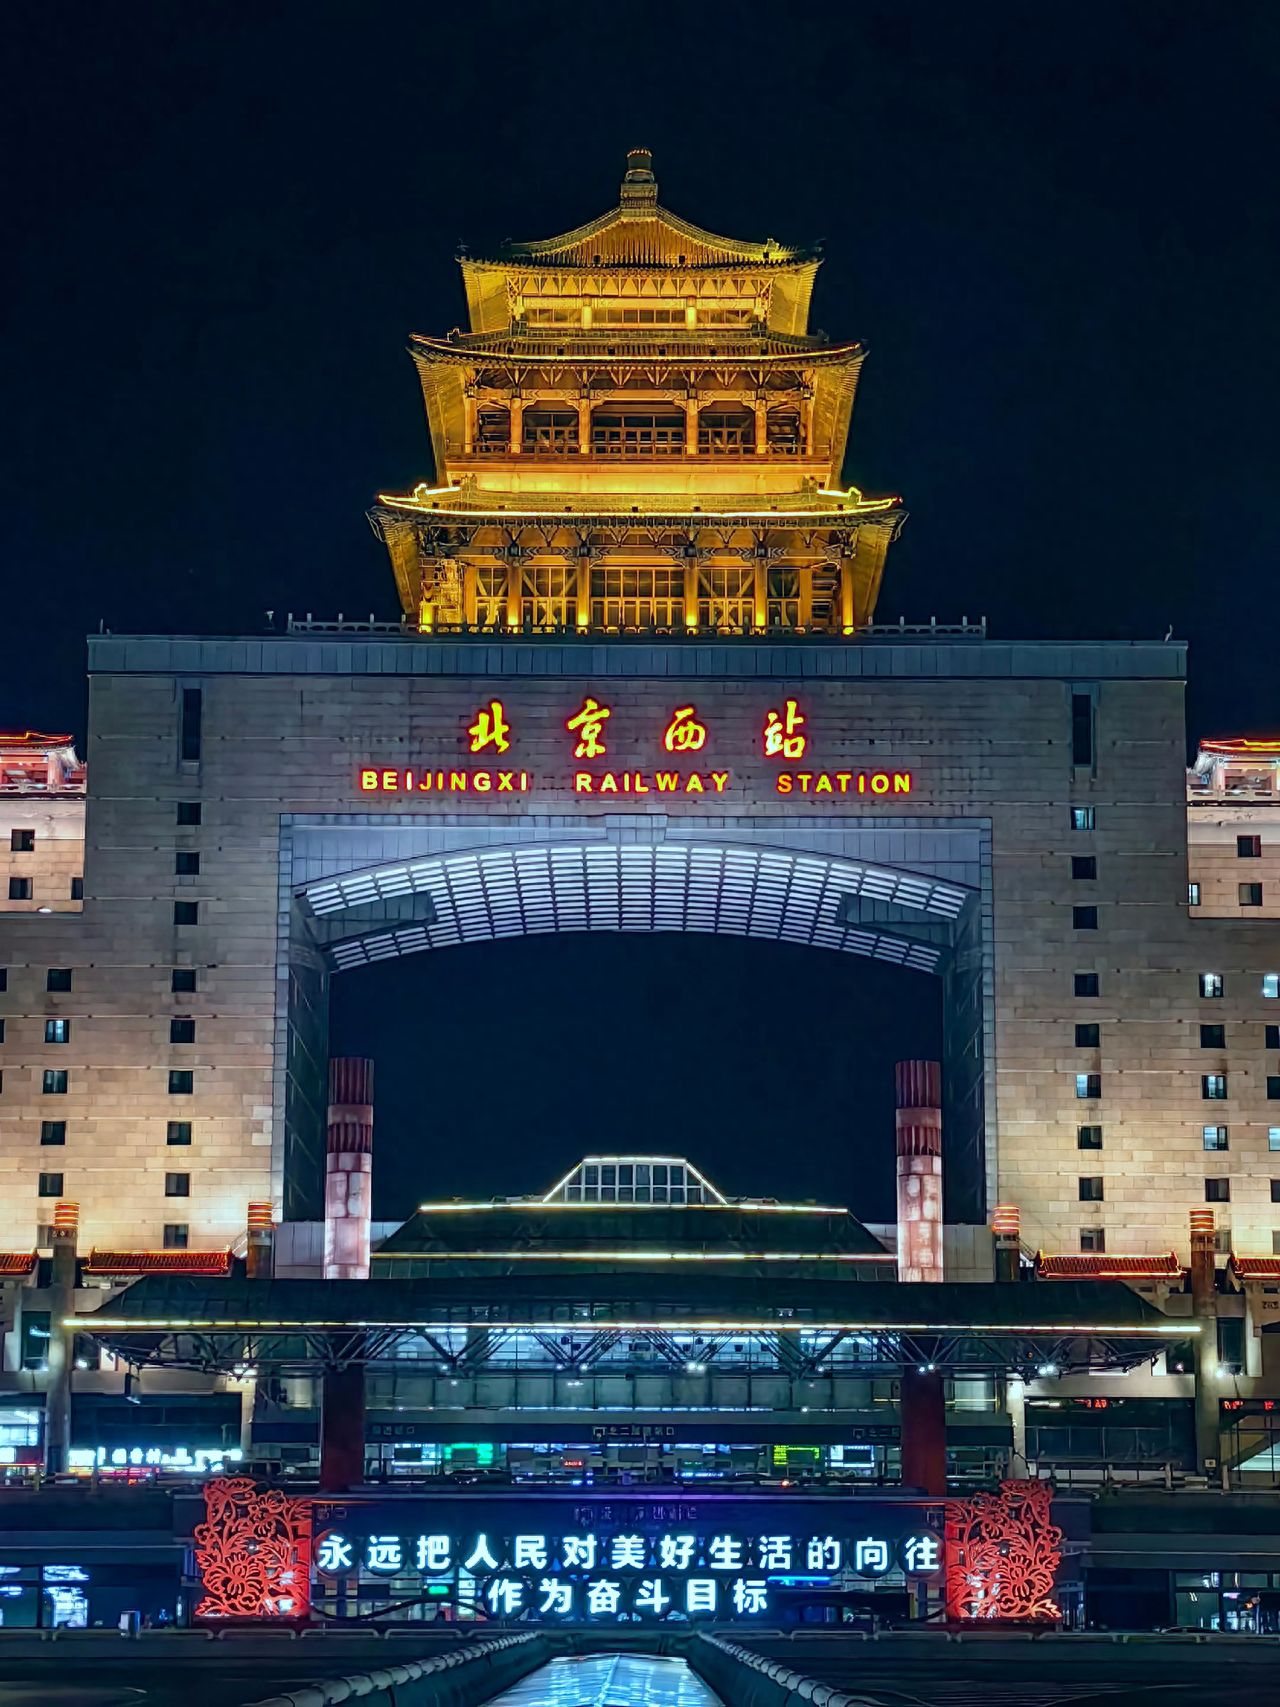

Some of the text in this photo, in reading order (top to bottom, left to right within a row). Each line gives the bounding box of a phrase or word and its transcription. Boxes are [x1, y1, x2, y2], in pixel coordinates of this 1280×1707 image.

[467, 698, 808, 761] 北京西站
[360, 769, 913, 794] BEIJINGXI RAILWAY STATION
[317, 1533, 941, 1572] 永远把人民对美好生活的向往
[487, 1577, 769, 1615] 作为奋斗目标
